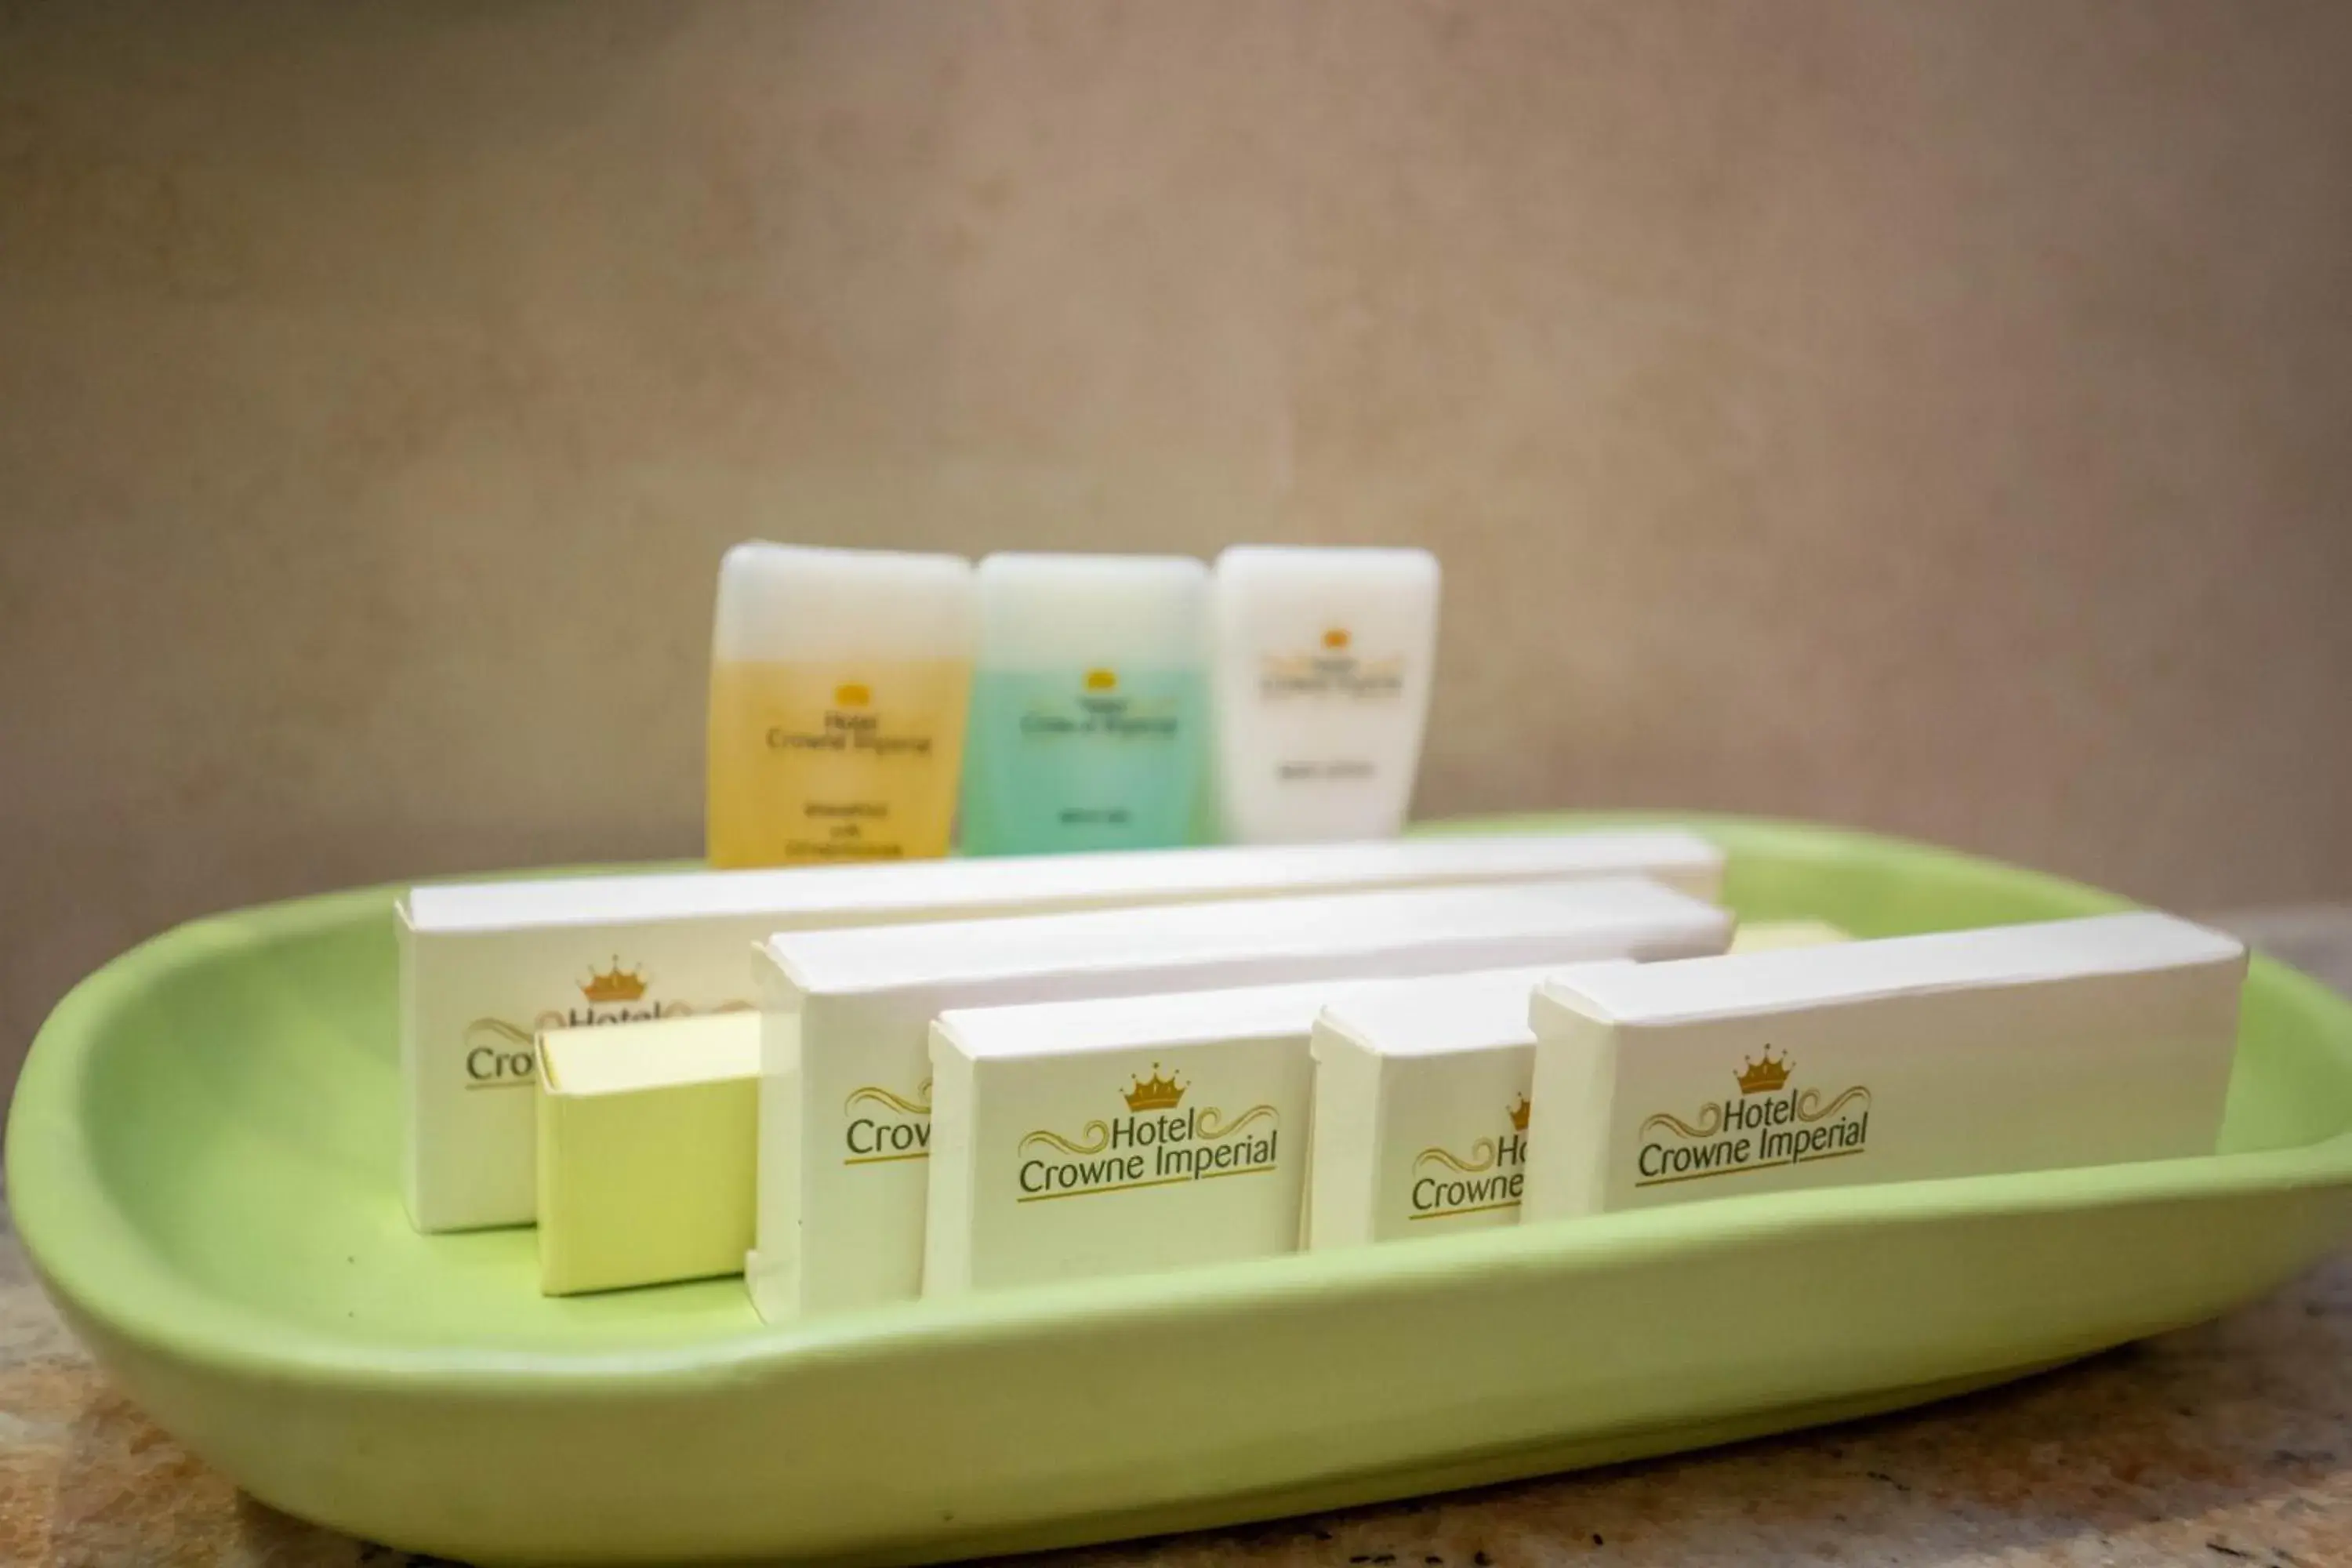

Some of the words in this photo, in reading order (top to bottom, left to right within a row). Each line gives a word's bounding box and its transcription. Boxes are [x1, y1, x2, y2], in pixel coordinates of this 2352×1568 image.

[466, 1046, 536, 1080] Cro
[1112, 1106, 1195, 1149] Hotel
[1722, 1088, 1798, 1132] Hotel
[1019, 1154, 1144, 1193] Crowne
[1156, 1129, 1278, 1180] Imperial
[1638, 1138, 1751, 1178] Crowne
[1759, 1111, 1868, 1164] Imperial
[1412, 1173, 1524, 1210] Crowne
